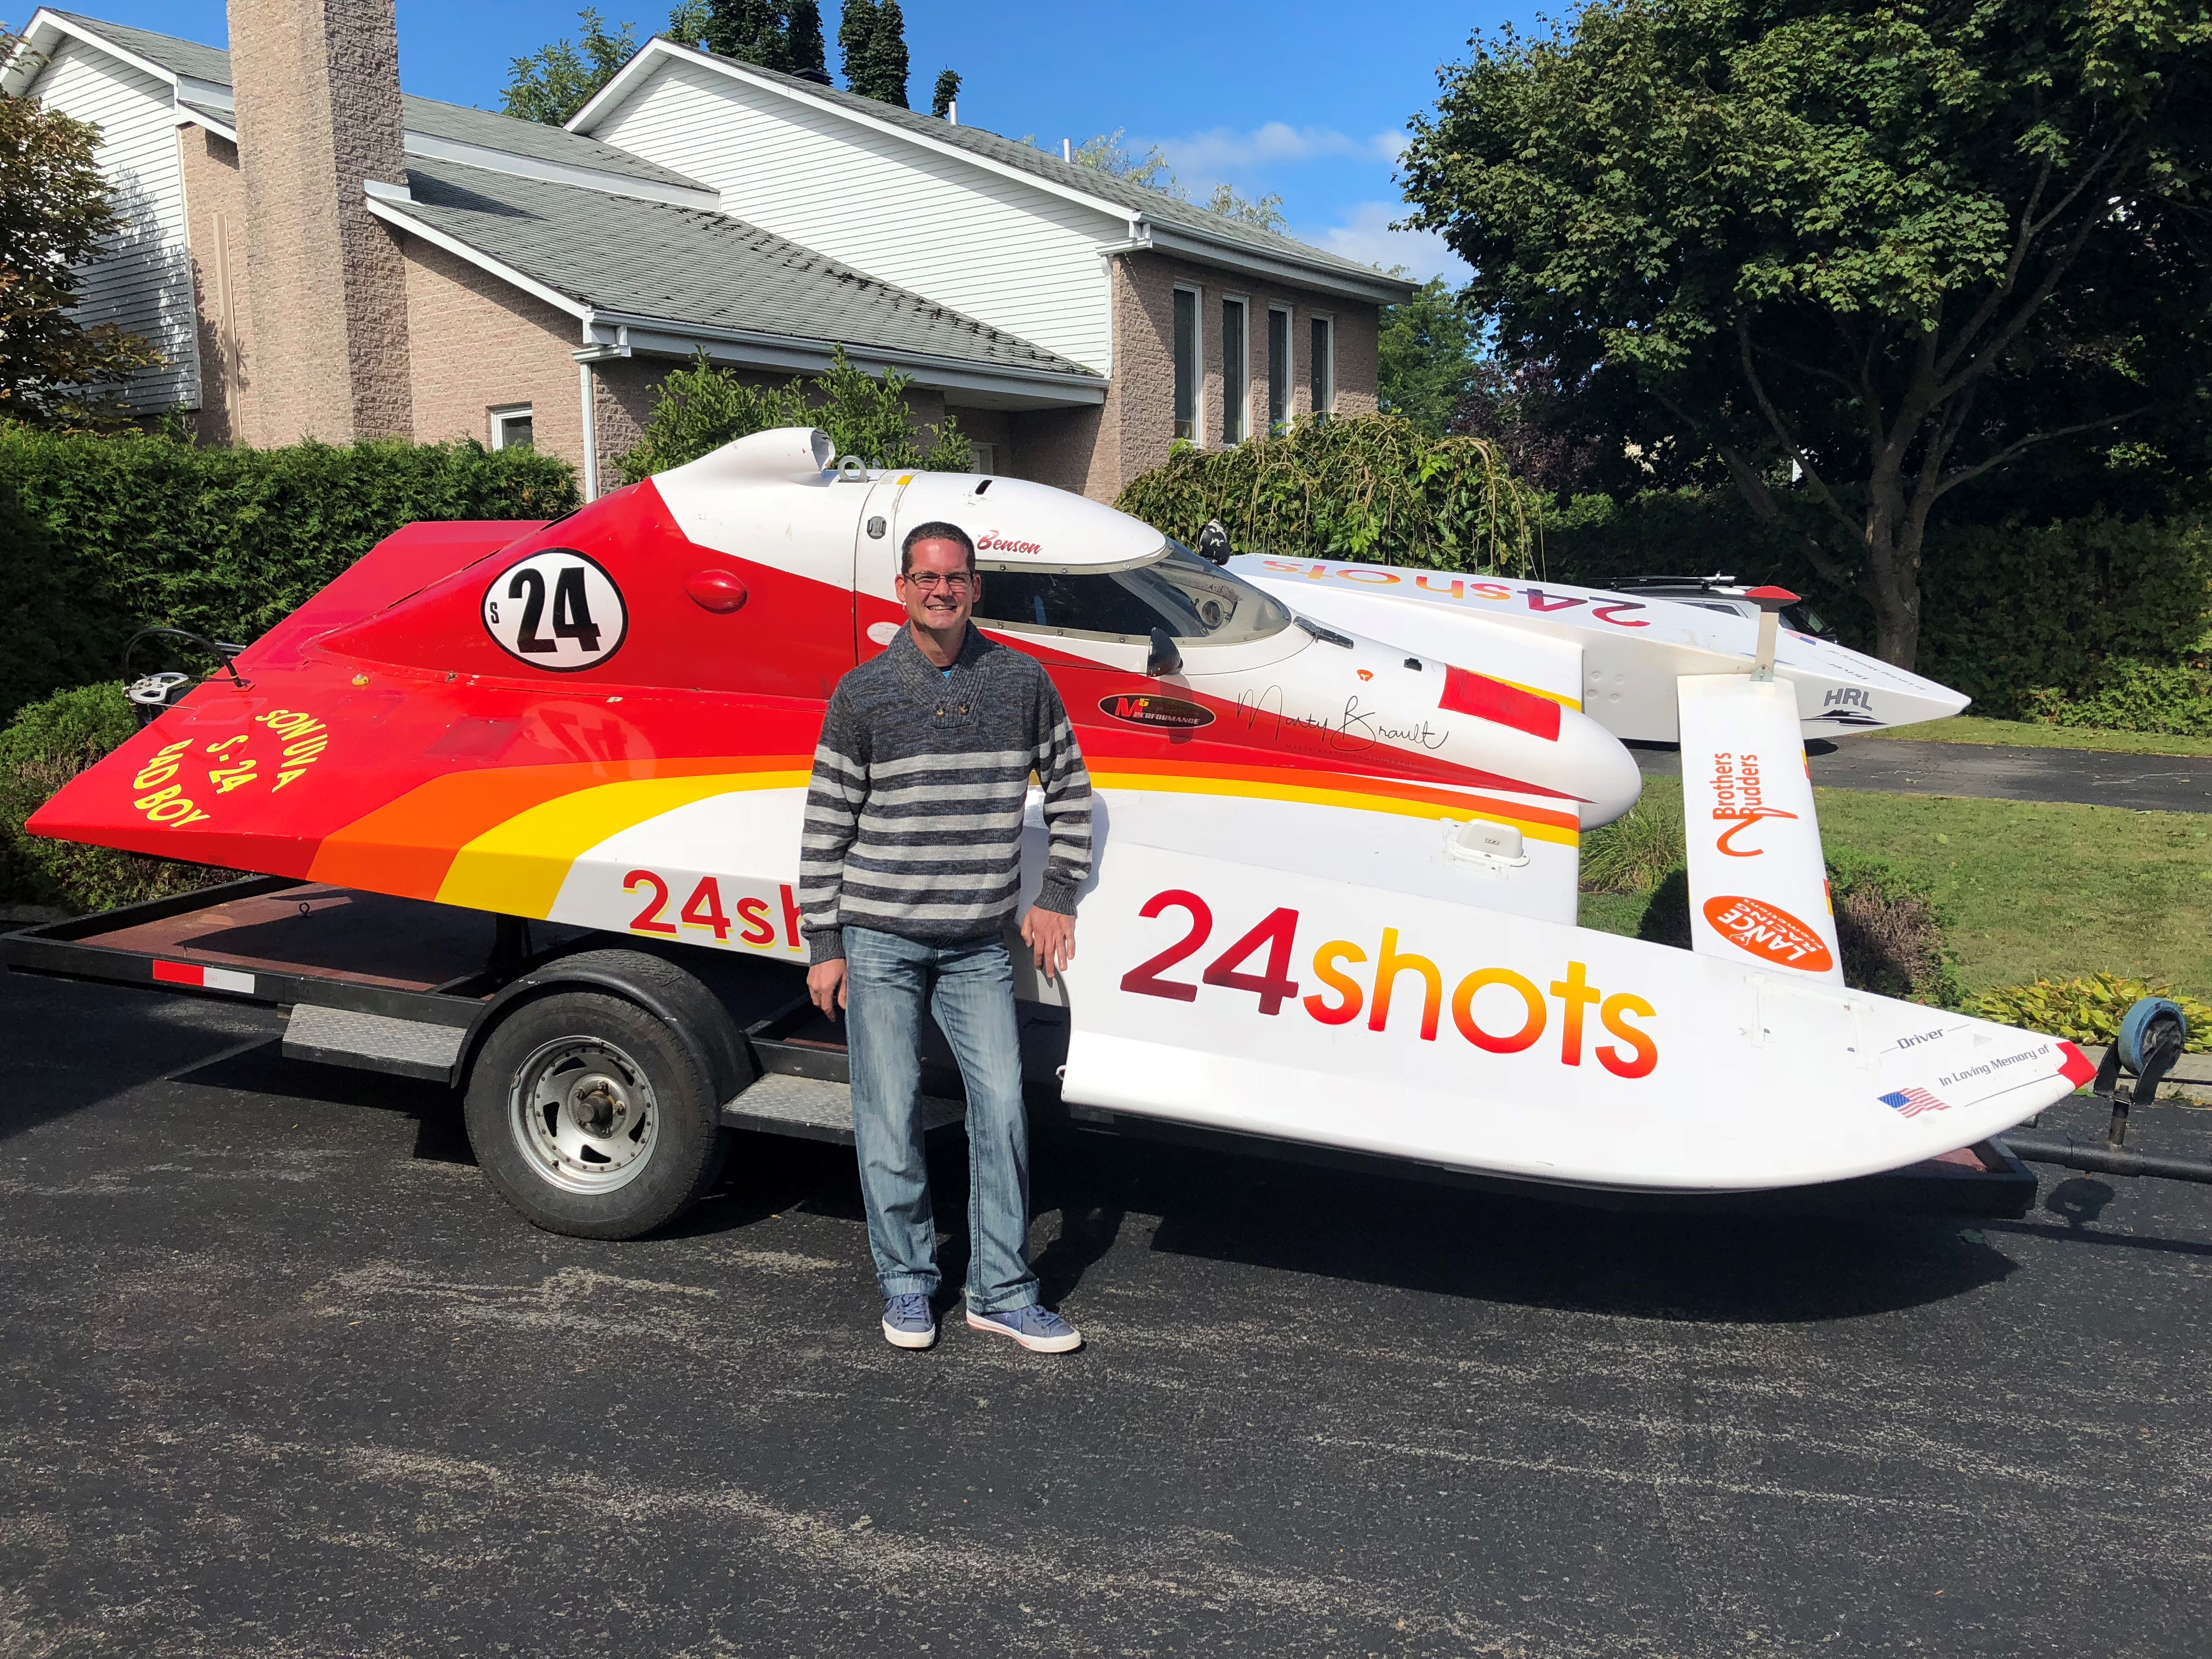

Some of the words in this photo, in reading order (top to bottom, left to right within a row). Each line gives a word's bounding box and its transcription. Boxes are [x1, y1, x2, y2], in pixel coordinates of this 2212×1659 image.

[977, 530, 1043, 555] Benson
[489, 602, 500, 624] S
[508, 567, 601, 653] 24
[1262, 560, 1651, 627] 24shots
[1133, 712, 1200, 725] PERFORMANCE
[1824, 689, 1872, 712] HRL
[133, 738, 194, 789] BAD
[1709, 753, 1736, 820] Brothers
[133, 784, 211, 827] BOY
[1717, 909, 1807, 961] LANCE
[1735, 902, 1817, 952] RACING
[1121, 889, 1658, 1079] 24shots
[1897, 1029, 1943, 1049] Driver
[1939, 1076, 1953, 1086] In
[1951, 1064, 1991, 1082] Loving
[1990, 1050, 2038, 1069] Memory
[2038, 1044, 2050, 1055] of
